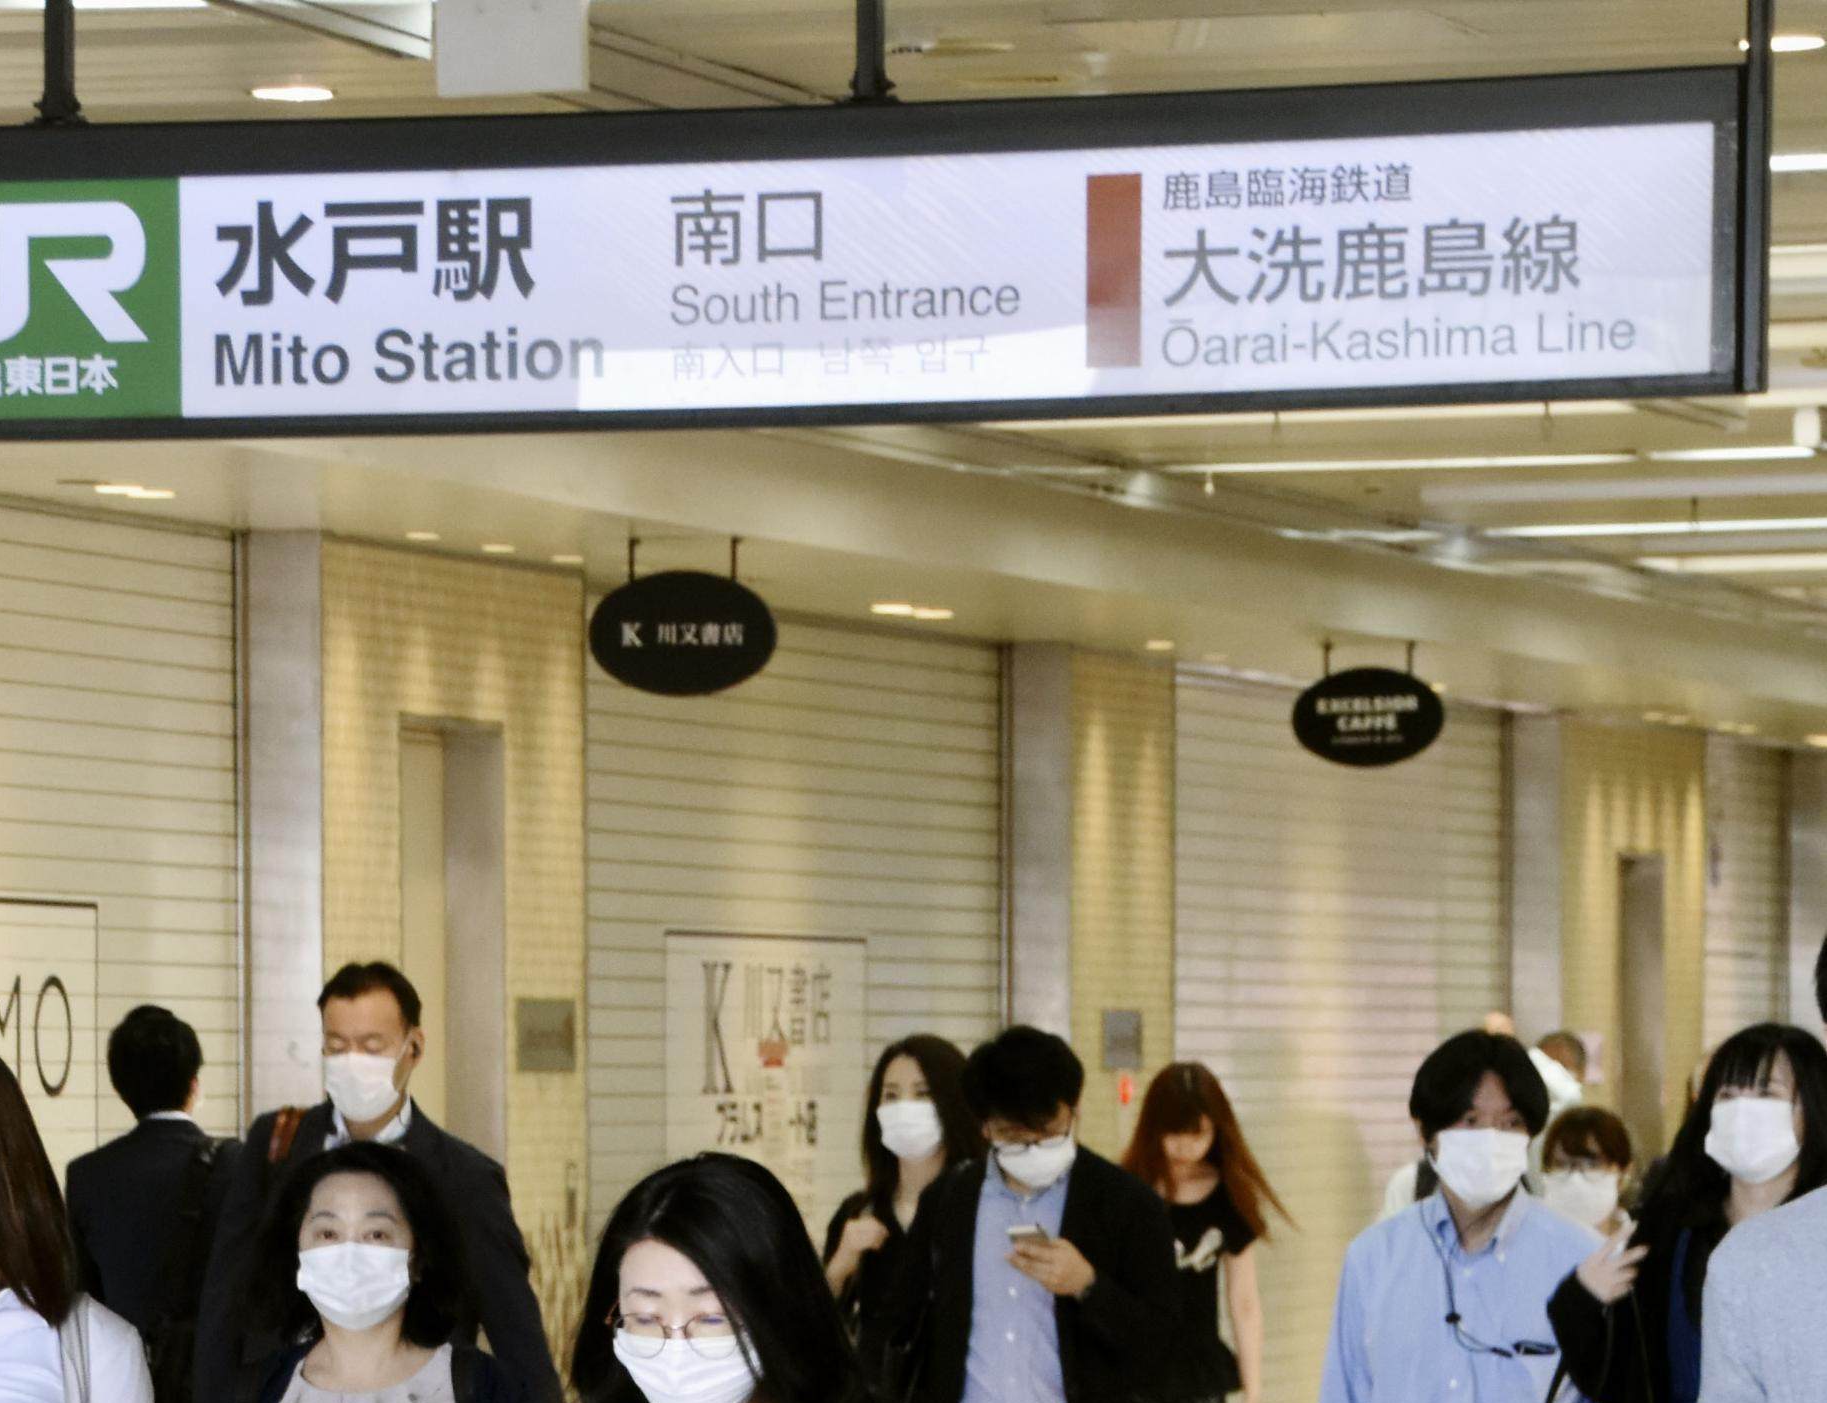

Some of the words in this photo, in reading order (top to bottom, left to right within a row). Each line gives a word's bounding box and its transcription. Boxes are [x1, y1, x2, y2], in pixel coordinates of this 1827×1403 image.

[1162, 164, 1412, 212] 鹿島臨海鉄道
[215, 196, 535, 307] 水戸駅
[671, 189, 823, 267] 南口
[1163, 213, 1581, 308] 大洗鹿島線
[671, 282, 800, 326] South
[819, 280, 1020, 322] Entrance
[214, 332, 351, 386] Mito
[374, 327, 604, 385] Station
[915, 333, 991, 374] 입구
[1537, 312, 1636, 354] Line
[672, 340, 785, 380] 南入口
